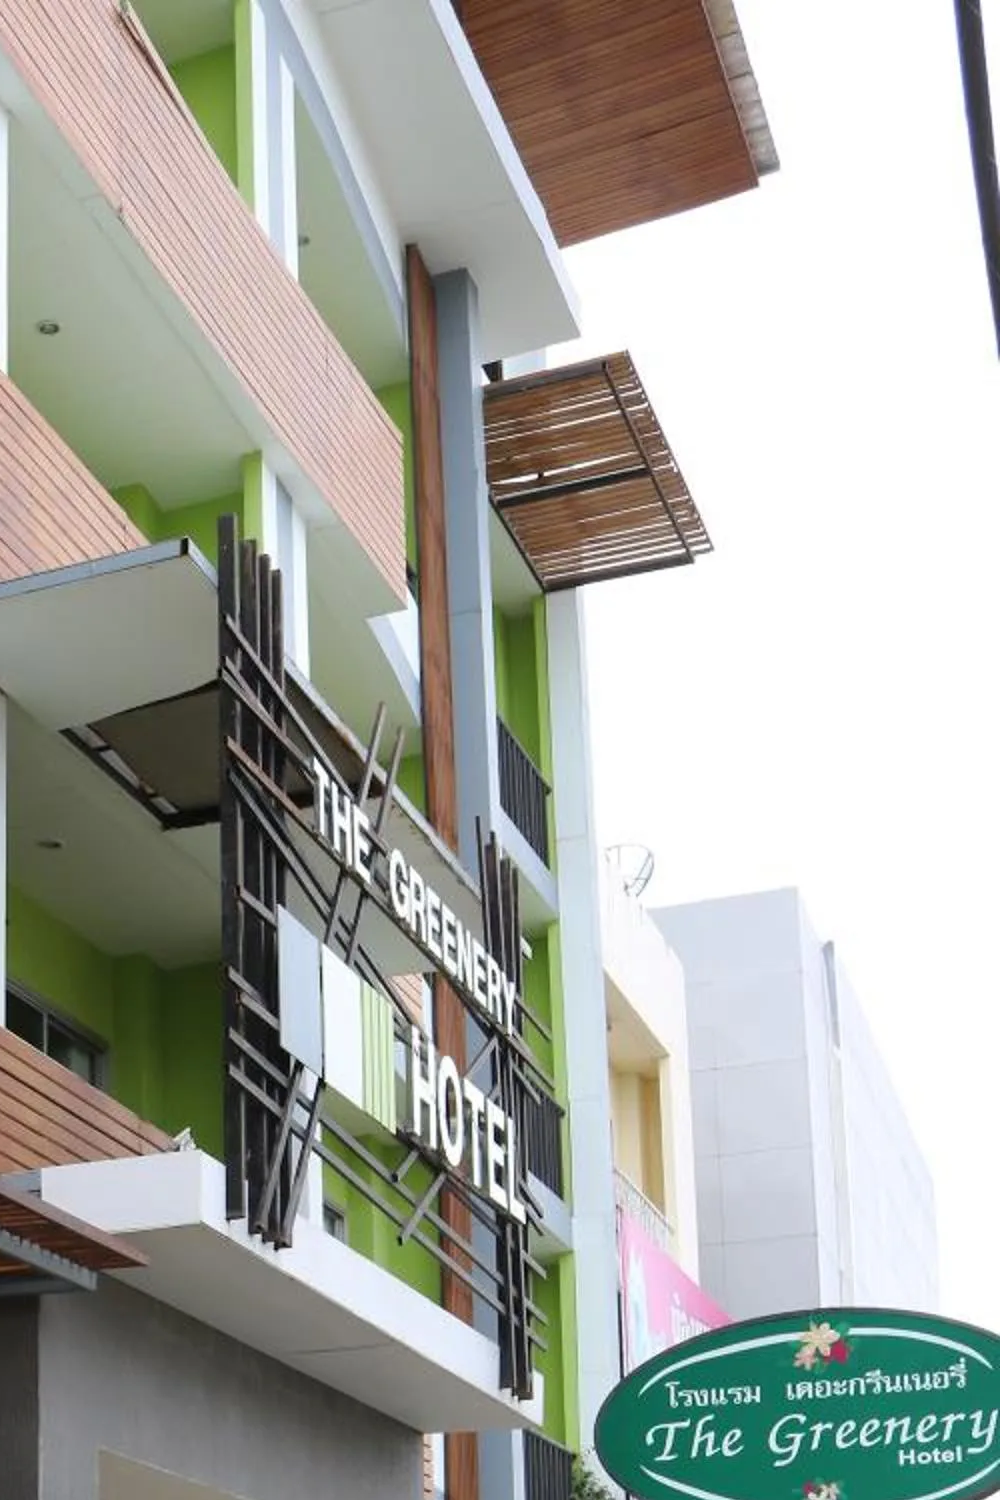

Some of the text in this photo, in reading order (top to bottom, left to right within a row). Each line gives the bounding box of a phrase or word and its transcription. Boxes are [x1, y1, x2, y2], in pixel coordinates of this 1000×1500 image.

[313, 756, 516, 1036] THE GREENERY
[411, 1024, 526, 1225] HOTEL
[665, 1357, 968, 1408] โรงแรม เดอะกรีนเนอรี่
[645, 1408, 999, 1467] The Greenery
[899, 1444, 962, 1466] Hotel
